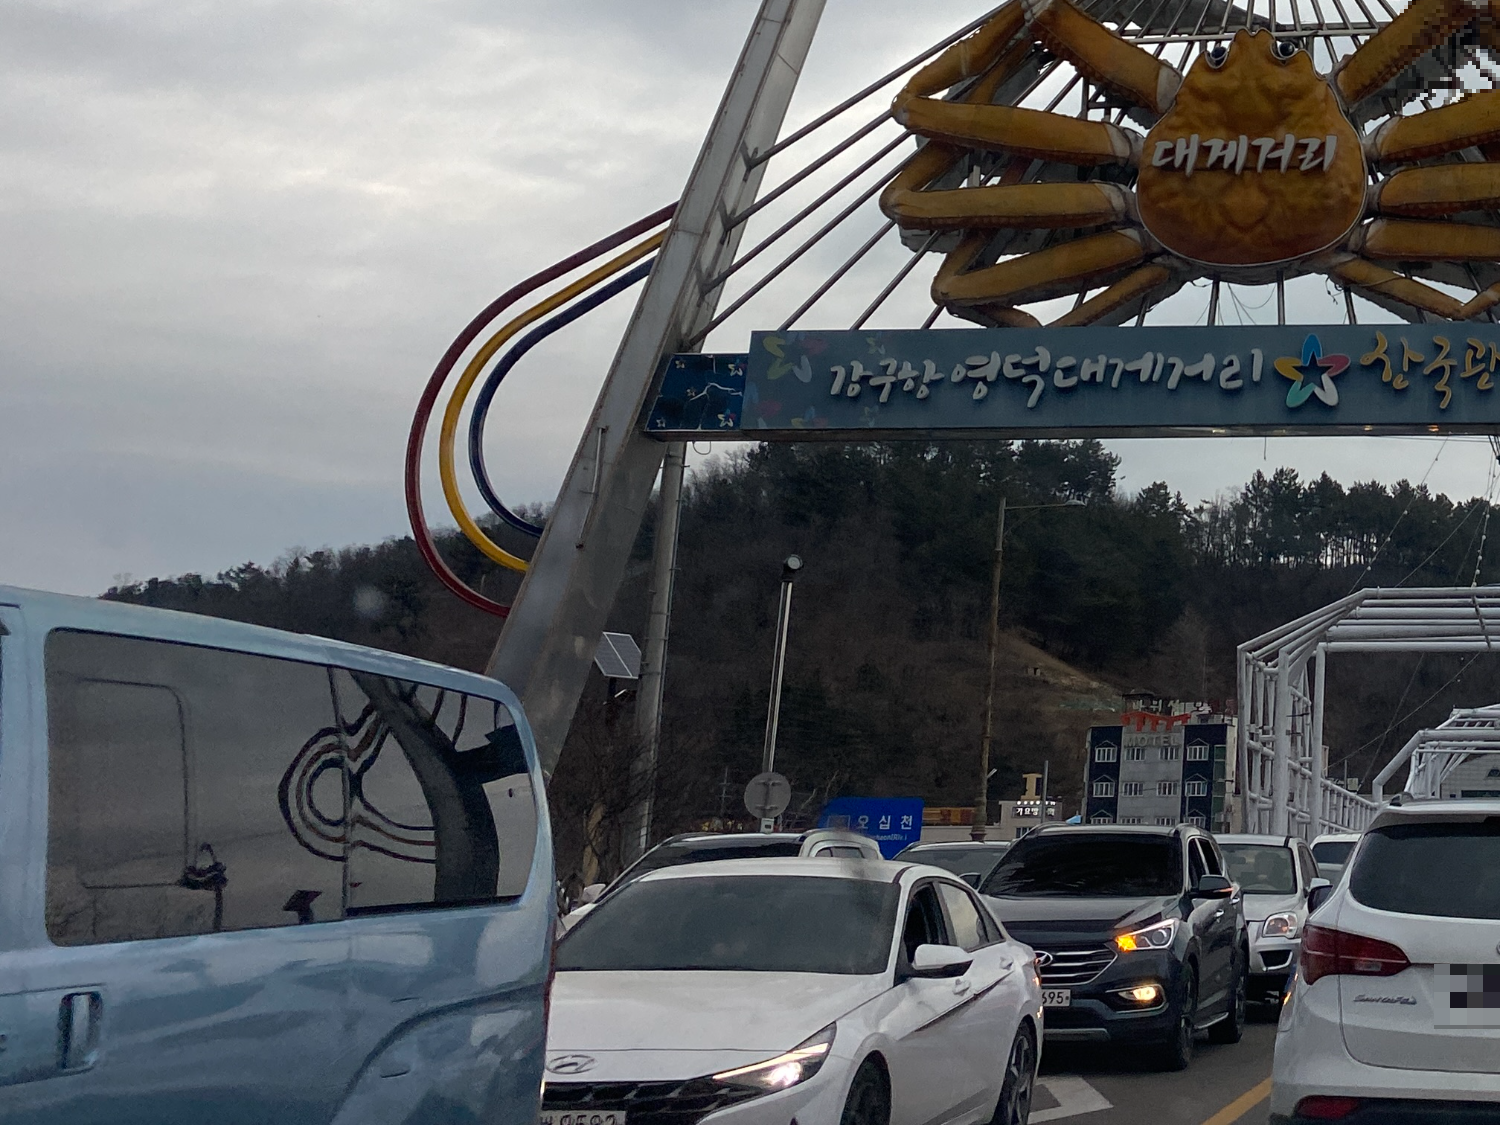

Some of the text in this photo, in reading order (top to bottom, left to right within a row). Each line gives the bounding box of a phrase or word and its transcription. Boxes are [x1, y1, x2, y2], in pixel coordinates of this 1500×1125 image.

[1152, 134, 1338, 176] 대게거리
[829, 357, 945, 403] 강구항
[1125, 735, 1180, 747] MOTEL
[858, 815, 912, 830] 오십천
